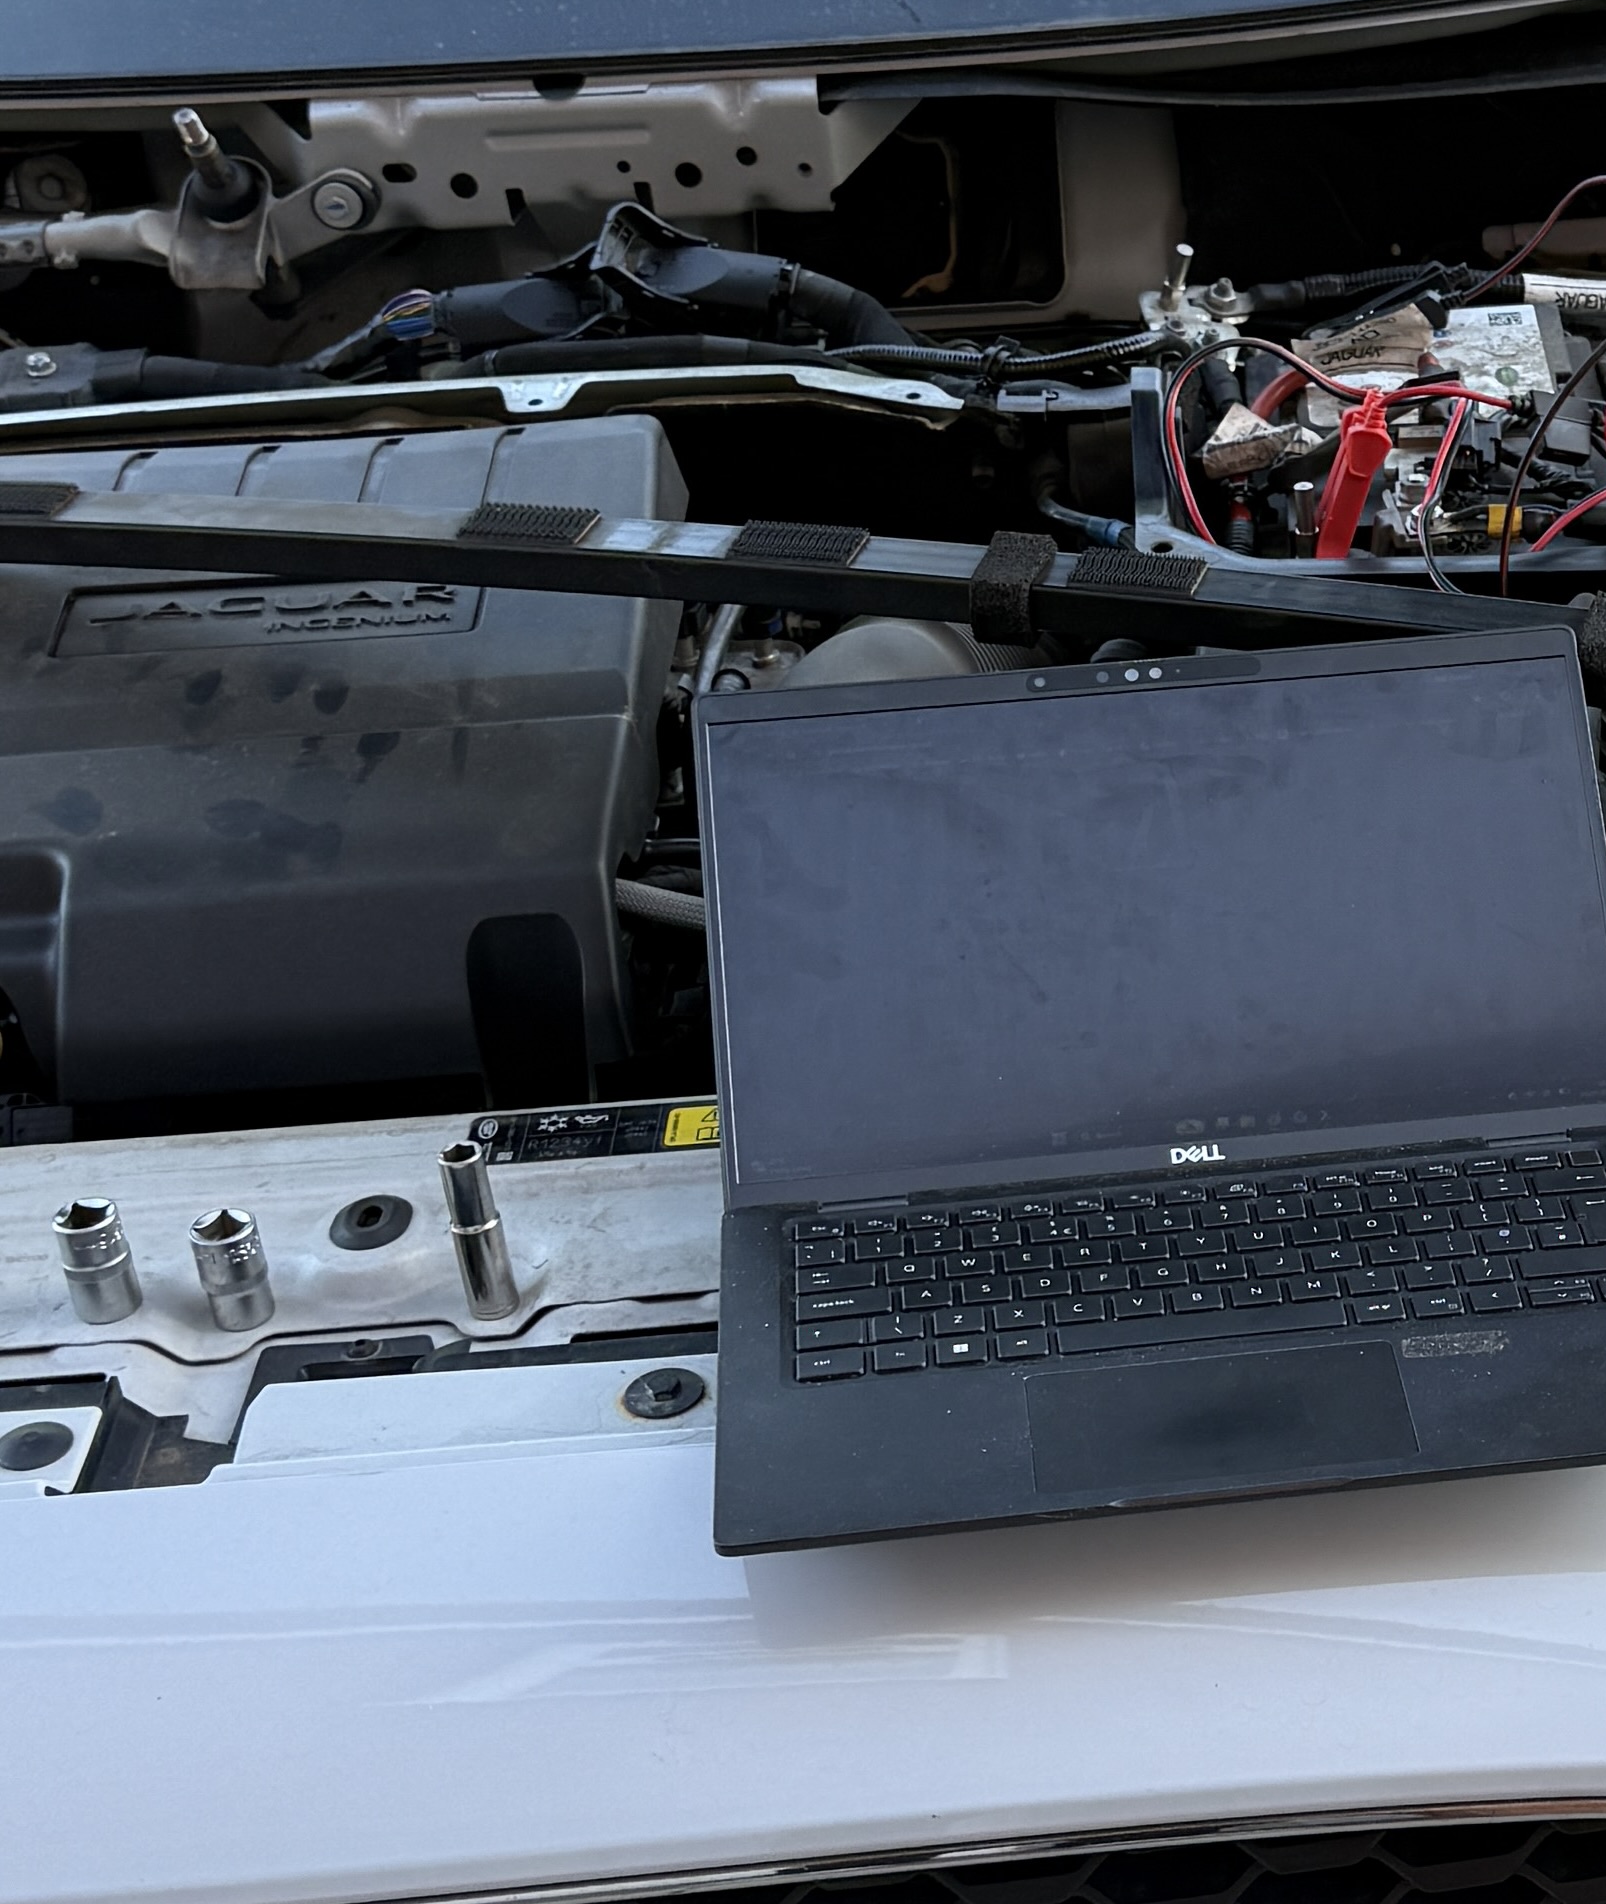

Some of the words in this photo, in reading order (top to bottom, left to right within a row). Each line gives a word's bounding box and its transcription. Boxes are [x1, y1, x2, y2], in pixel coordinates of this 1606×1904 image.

[90, 585, 456, 625] JAGUAR
[266, 612, 452, 635] INGENIUM
[1170, 1144, 1226, 1165] DELL
